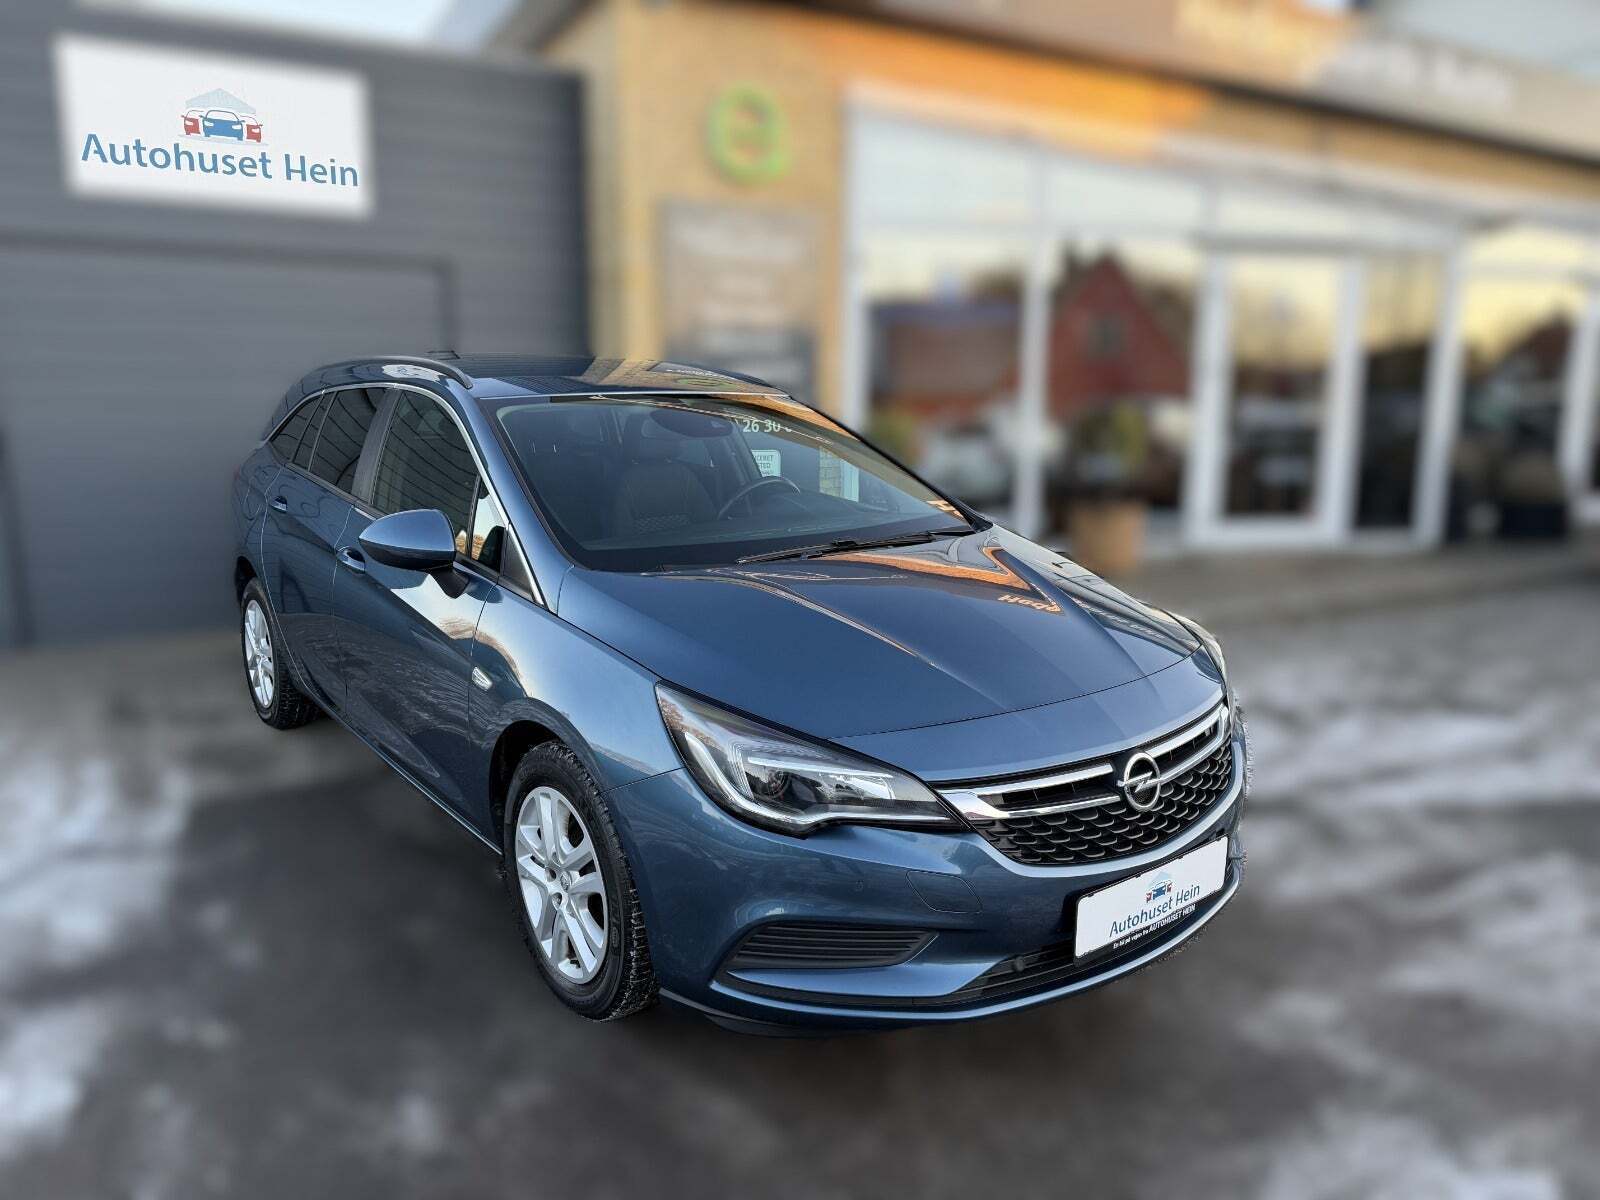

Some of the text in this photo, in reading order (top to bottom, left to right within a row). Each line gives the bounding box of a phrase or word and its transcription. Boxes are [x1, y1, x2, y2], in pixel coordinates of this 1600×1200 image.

[82, 133, 359, 187] Autohuset Hein
[743, 419, 760, 433] 26
[1109, 884, 1201, 938] Autohuset Hein
[1149, 911, 1182, 933] AUTOHUSET
